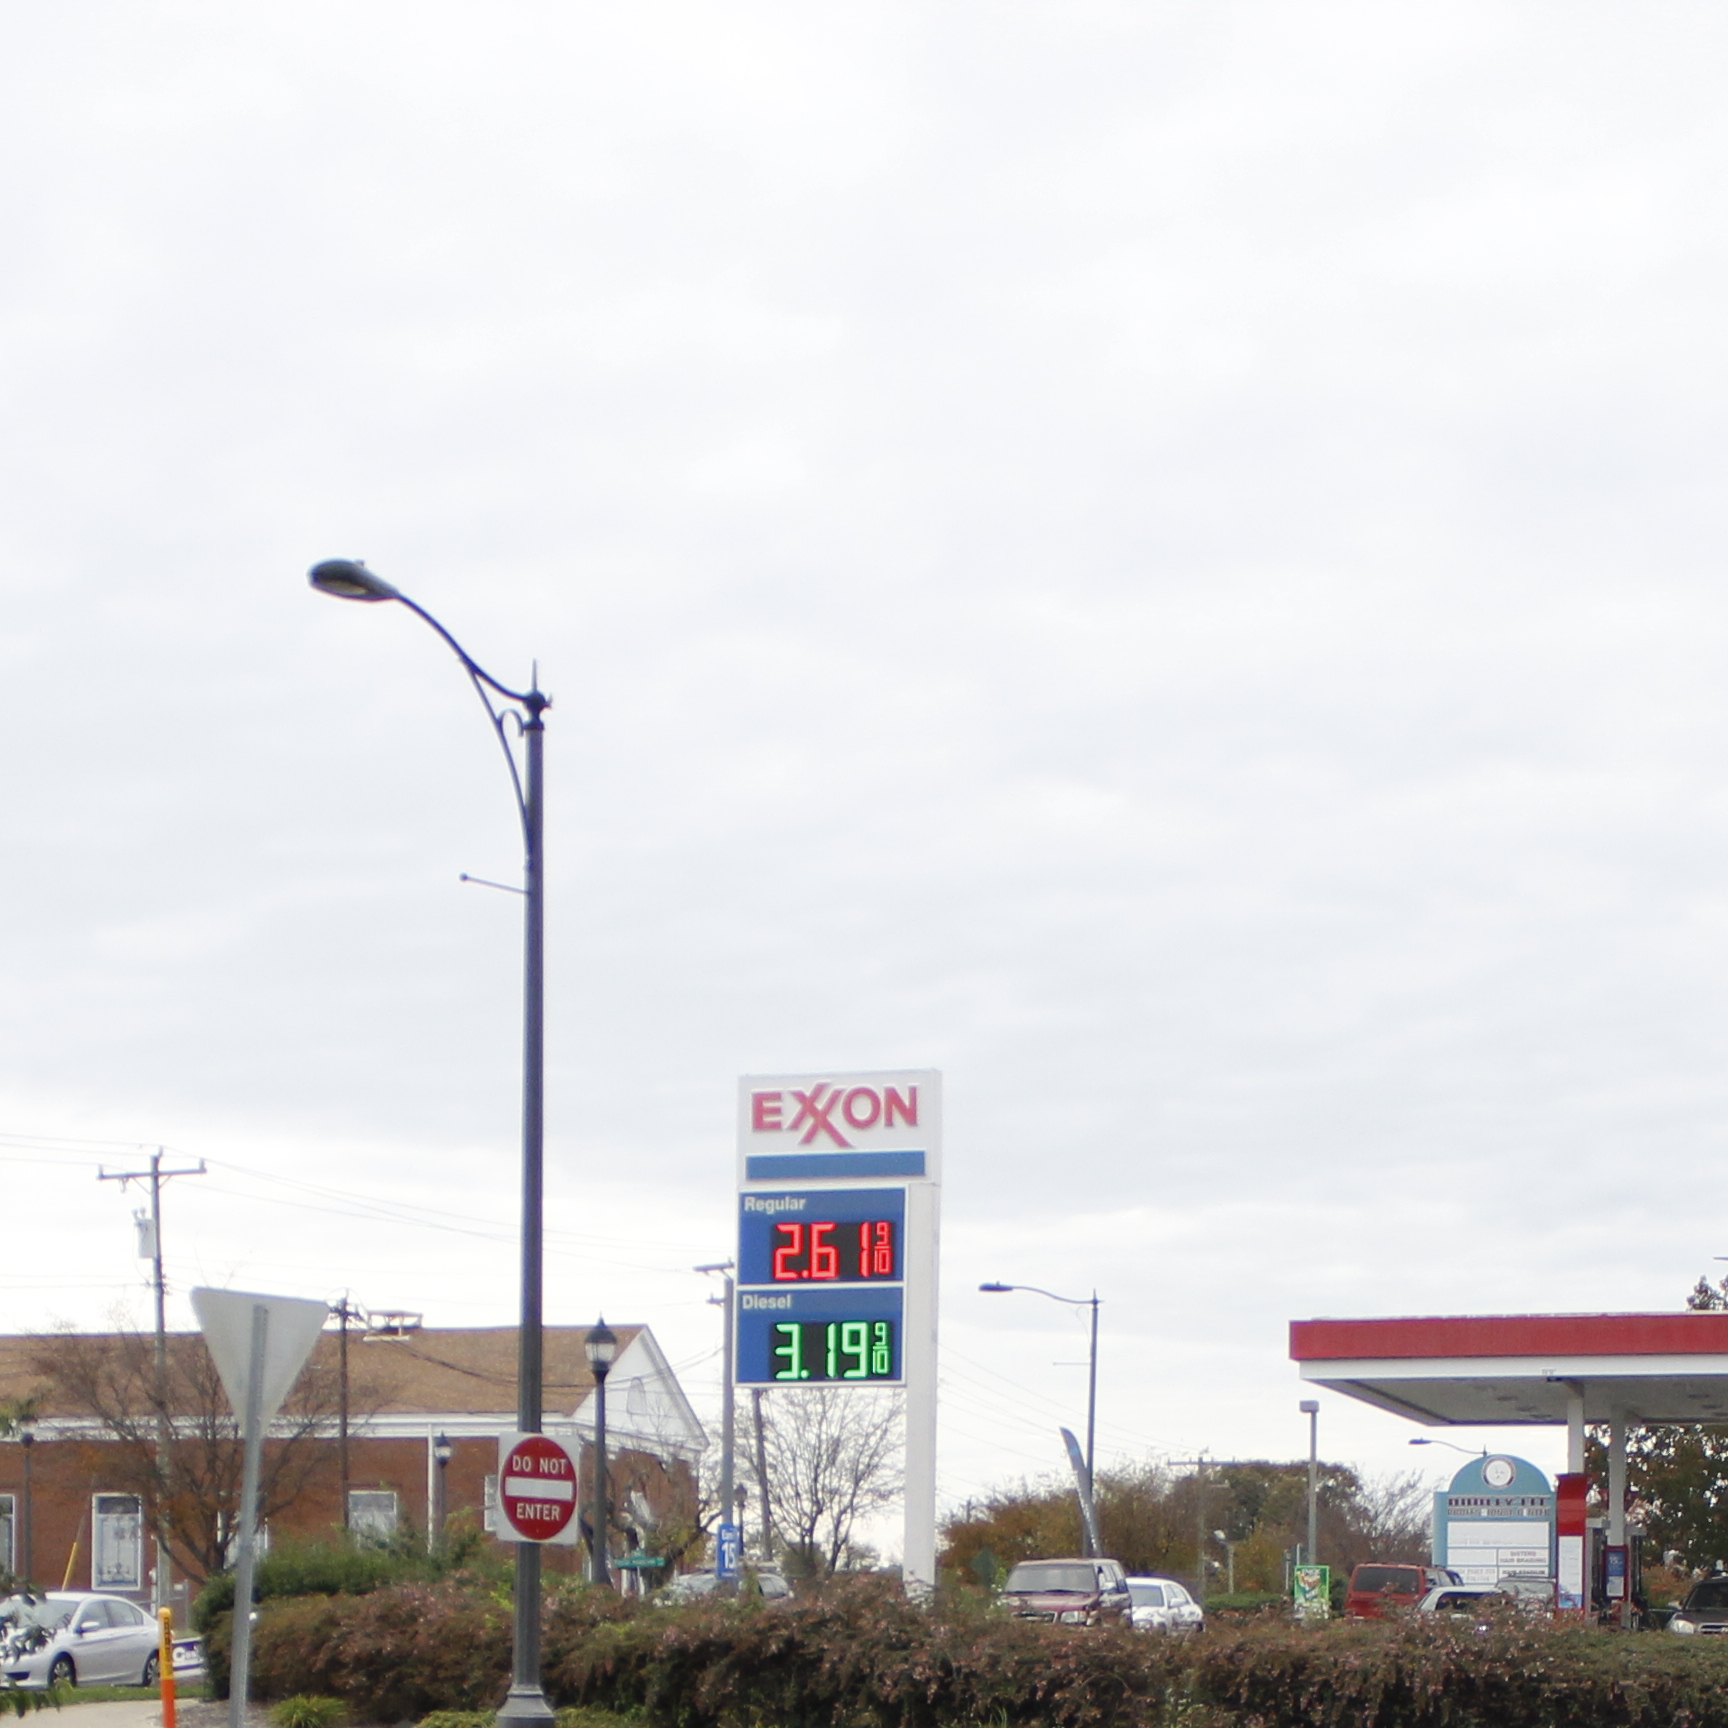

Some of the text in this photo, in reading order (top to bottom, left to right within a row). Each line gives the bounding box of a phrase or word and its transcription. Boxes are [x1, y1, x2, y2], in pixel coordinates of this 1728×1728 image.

[751, 1081, 919, 1148] EXXON
[743, 1196, 807, 1214] Regular
[742, 1294, 793, 1309] Diesel
[513, 1455, 567, 1474] DO NOT
[516, 1503, 561, 1521] ENTER
[721, 1542, 736, 1569] 15
